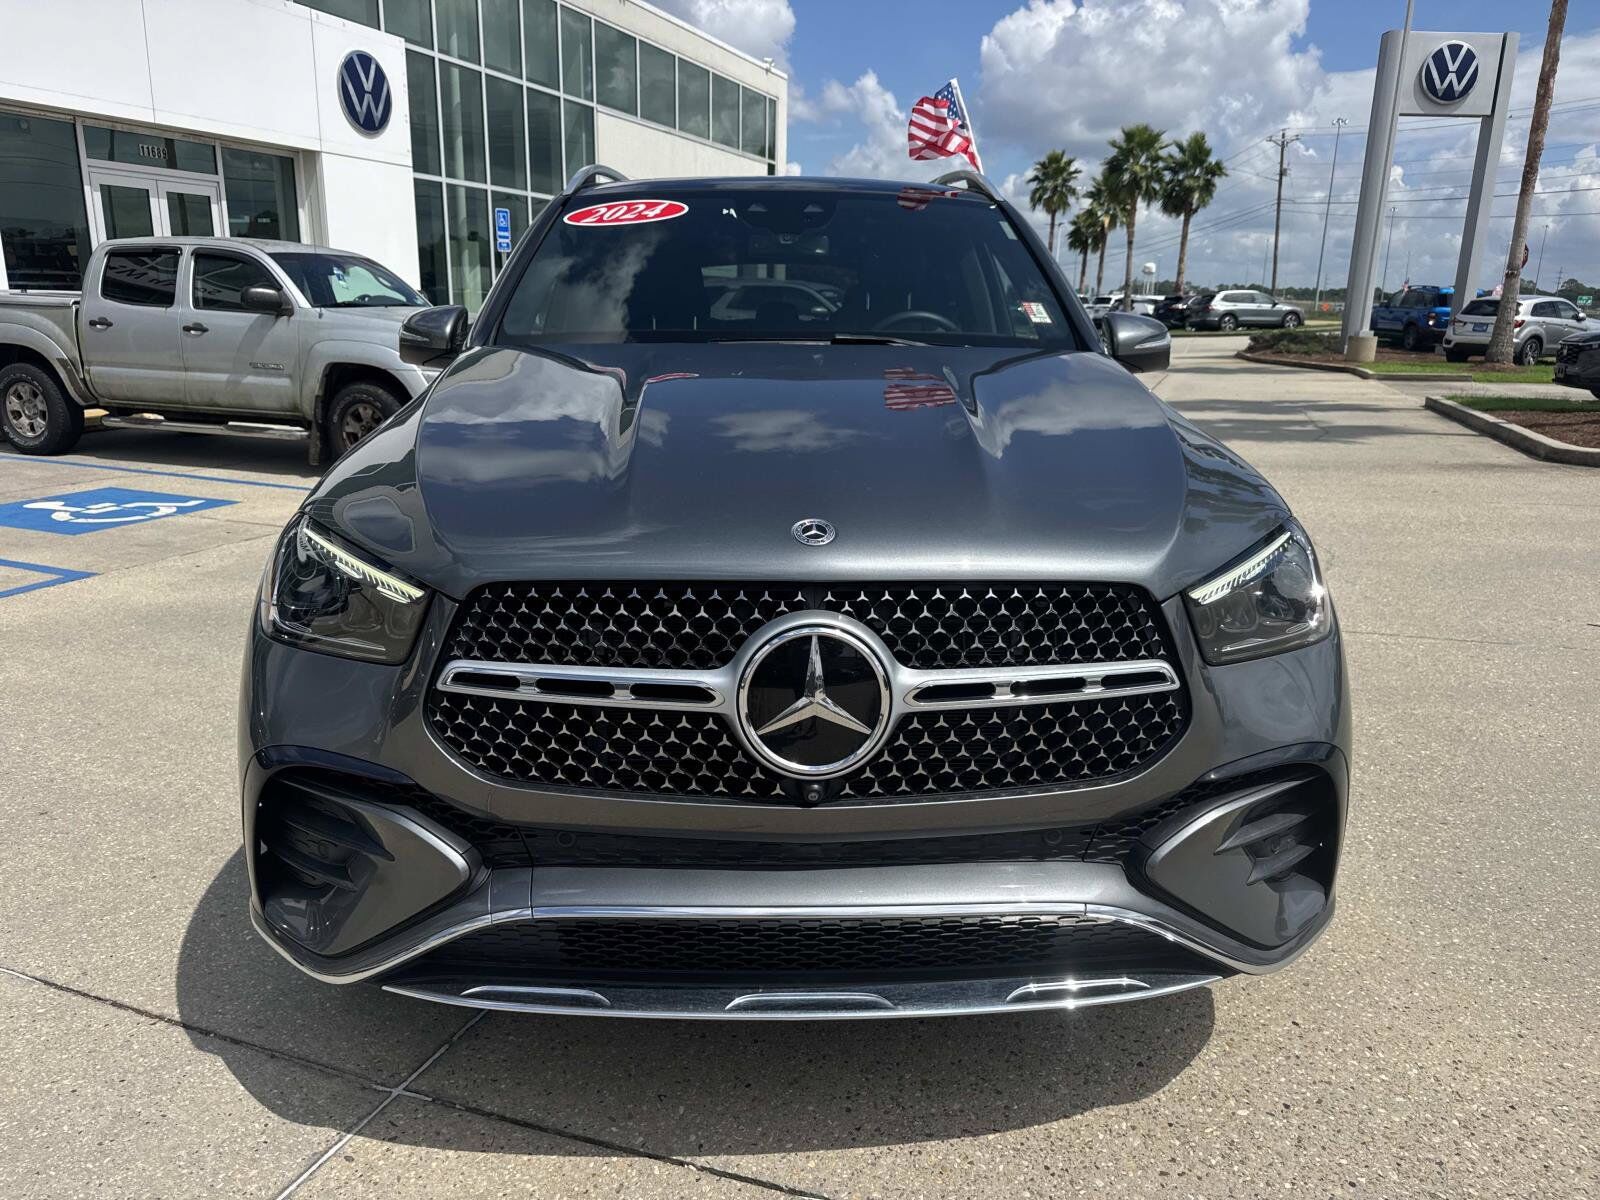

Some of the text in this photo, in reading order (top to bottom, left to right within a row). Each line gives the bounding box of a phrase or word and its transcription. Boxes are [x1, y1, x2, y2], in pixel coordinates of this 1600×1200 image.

[339, 51, 391, 130] VW
[1425, 42, 1479, 99] VW
[580, 202, 670, 223] 2024
